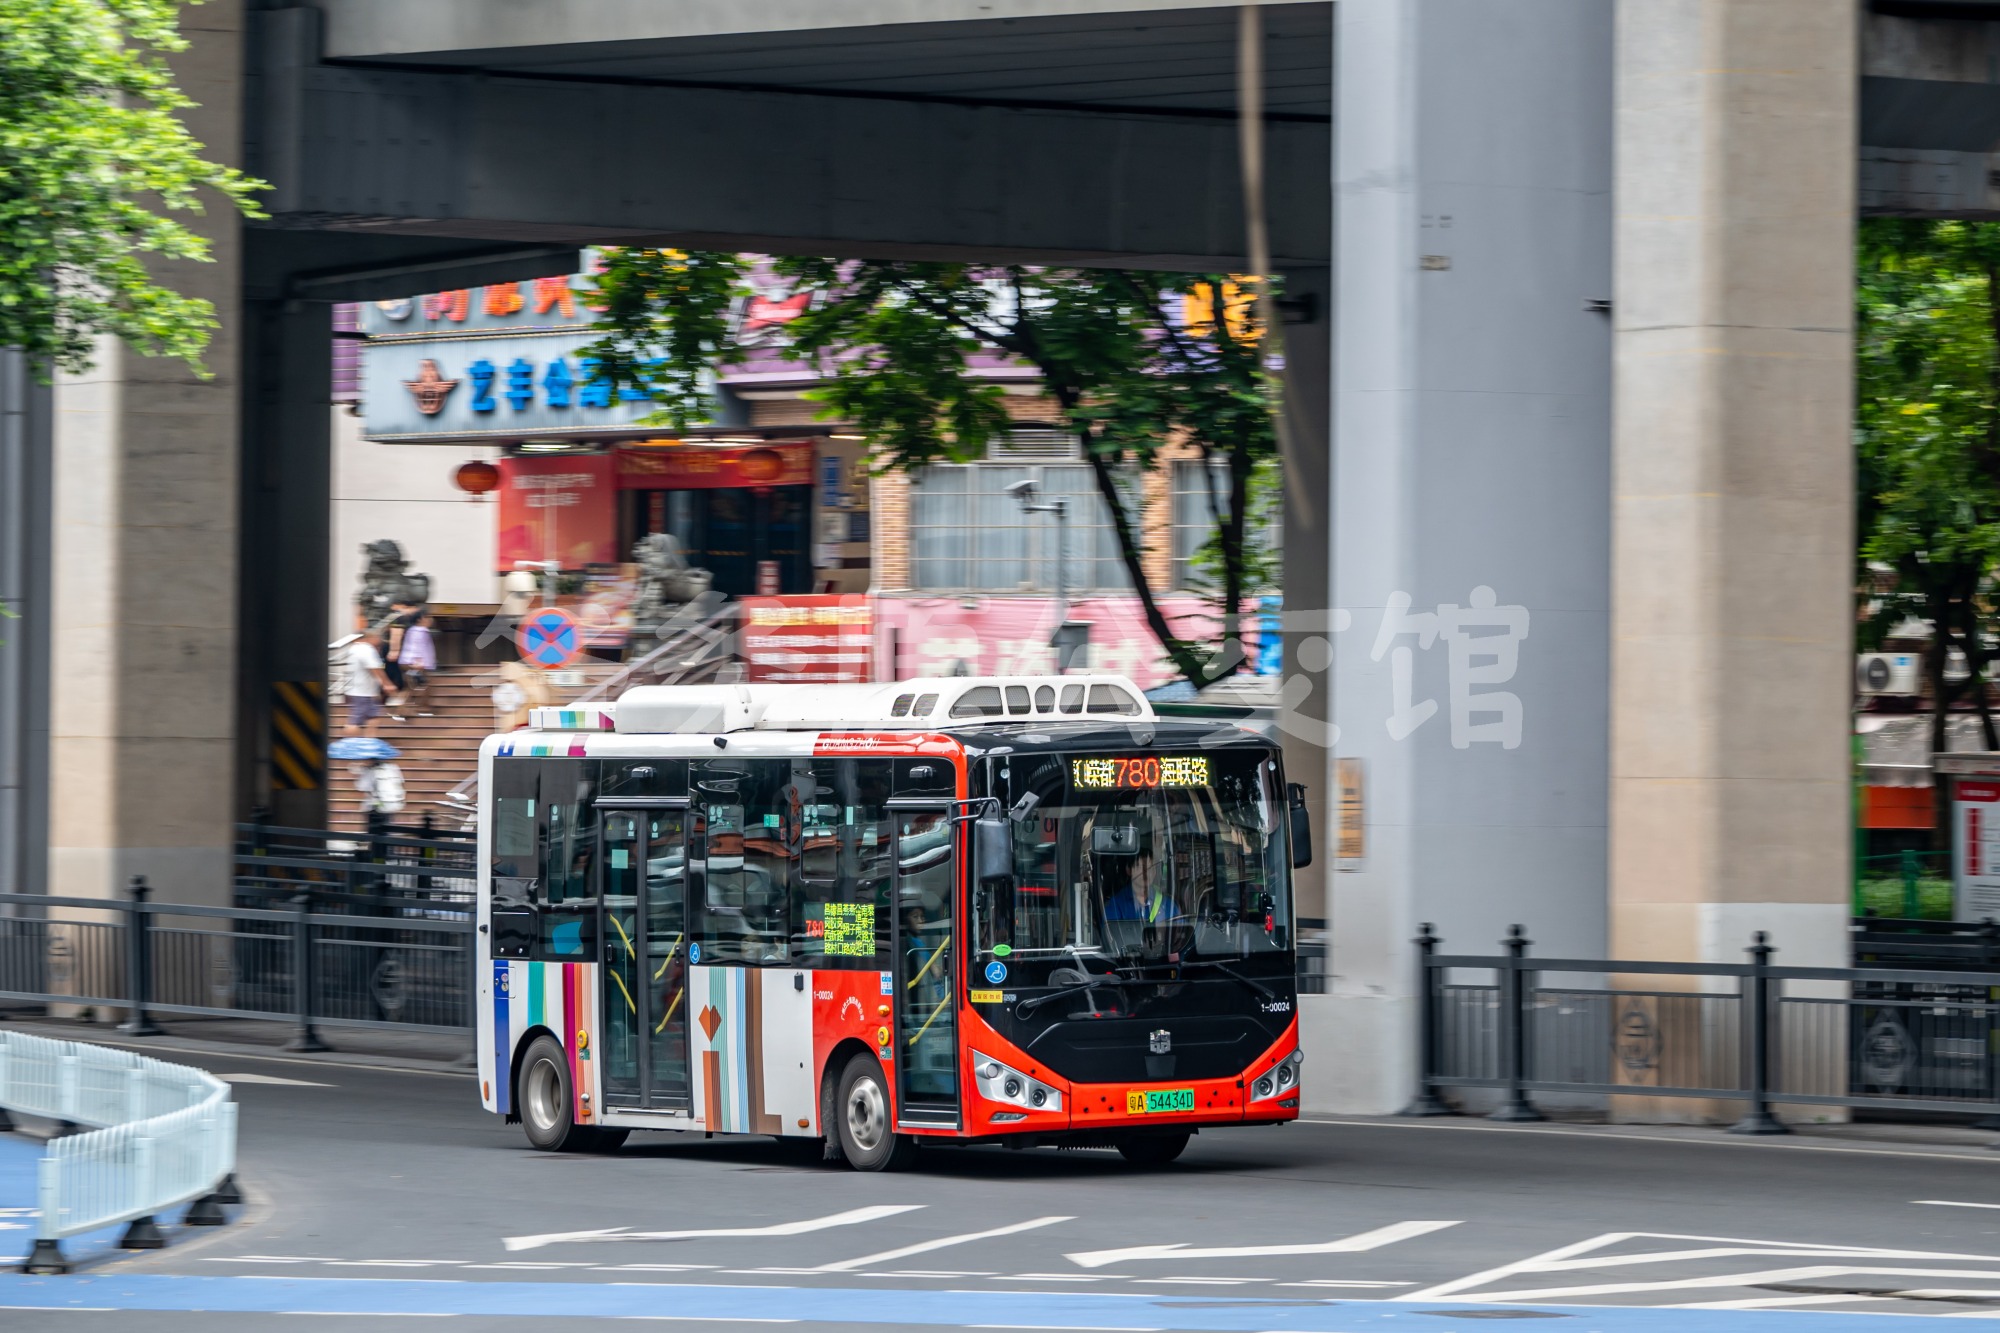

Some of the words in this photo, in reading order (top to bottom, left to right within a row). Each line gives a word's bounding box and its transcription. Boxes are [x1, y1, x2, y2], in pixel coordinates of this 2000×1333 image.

[1114, 757, 1160, 787] 780
[1160, 757, 1208, 785] 海联路
[805, 920, 824, 938] 780
[813, 990, 834, 1001] 1-00024
[1261, 1001, 1290, 1013] 1-00024
